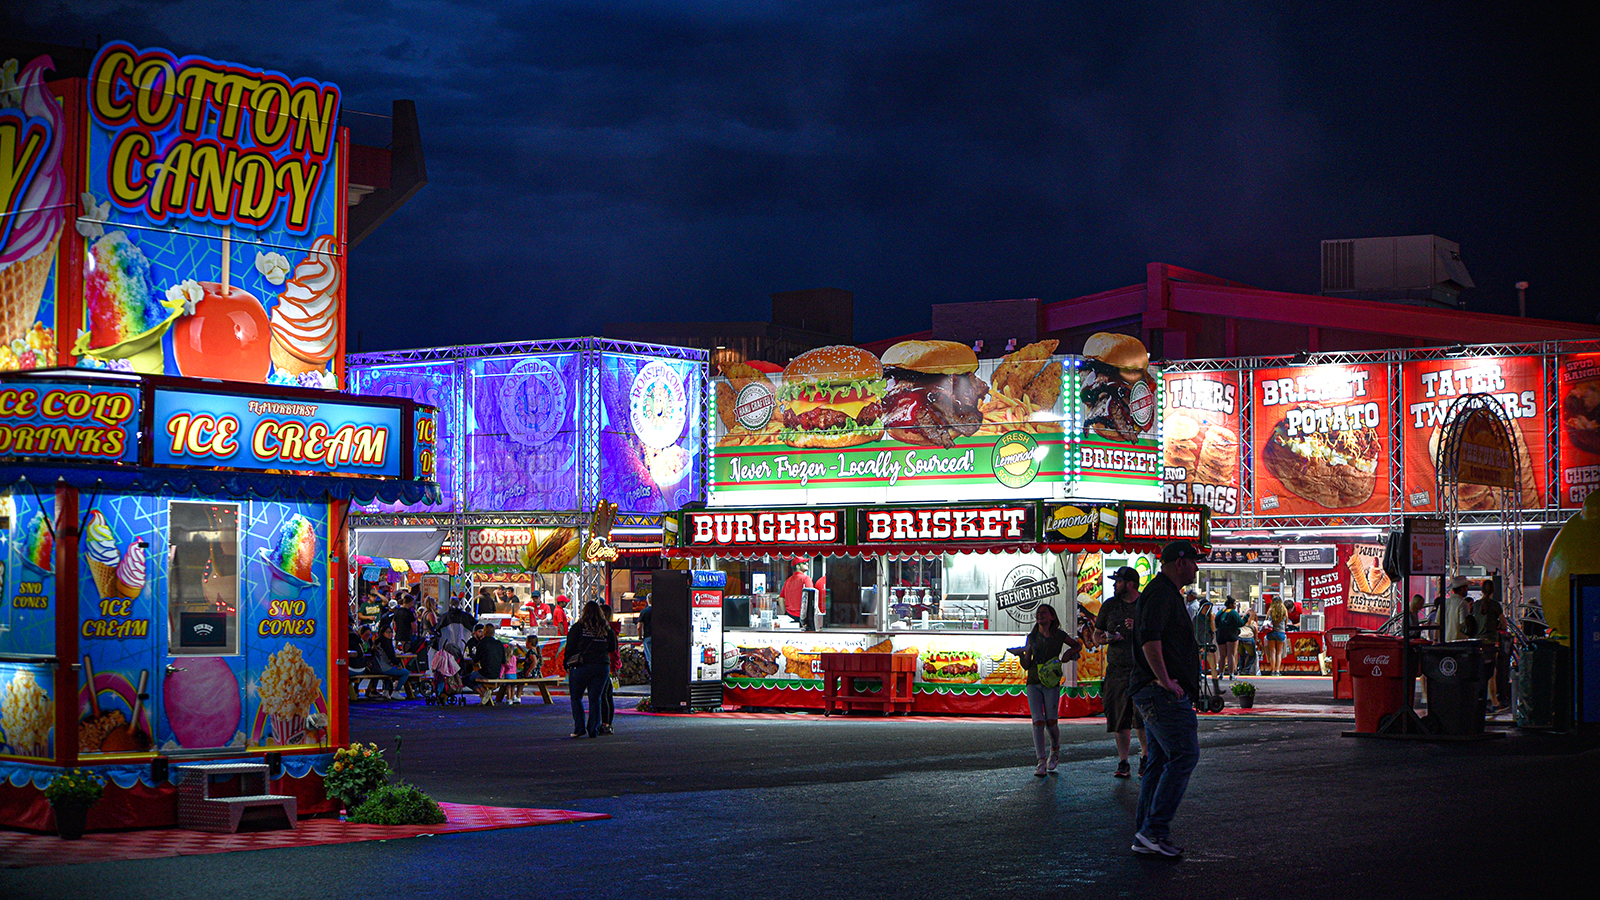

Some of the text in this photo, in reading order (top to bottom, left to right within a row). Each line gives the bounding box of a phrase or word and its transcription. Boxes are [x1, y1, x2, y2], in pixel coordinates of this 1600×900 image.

[95, 51, 335, 154] COTTON
[112, 134, 321, 225] CANDY
[1566, 358, 1594, 371] SPUD
[503, 362, 563, 397] ROASTED CORN
[1421, 365, 1505, 398] TATER
[0, 391, 132, 425] CE COLD
[248, 401, 318, 417] FLAVORBURST
[1286, 402, 1380, 436] POTATO
[168, 415, 238, 454] ICE
[254, 421, 386, 465] CREAM
[1002, 432, 1030, 445] FRESH
[729, 457, 771, 483] Never
[773, 456, 827, 486] Frozen
[903, 449, 975, 477] Sourced!
[1081, 447, 1157, 472] BRISKET
[997, 468, 1035, 486] SQUEEZED
[1164, 468, 1186, 480] AND
[1192, 483, 1238, 514] DOGS
[693, 511, 836, 543] BURGERS
[868, 509, 1025, 540] BRISKET
[1046, 509, 1099, 531] Lemonade
[1125, 510, 1200, 537] FRENCH FRIES
[470, 529, 531, 545] ROASTED
[470, 546, 516, 563] CORN
[587, 542, 616, 559] Corn
[19, 582, 42, 594] SNO
[1308, 572, 1338, 586] TASTY
[999, 581, 1056, 607] FRENCH FRIES
[1310, 584, 1343, 598] SPUDS
[13, 596, 48, 609] CONES
[99, 599, 131, 616] ICE
[268, 600, 306, 616] SNO
[1324, 596, 1343, 607] ERE
[1350, 596, 1391, 609] TASTY FOOD
[82, 619, 148, 637] CREAM
[258, 619, 315, 636] CONES
